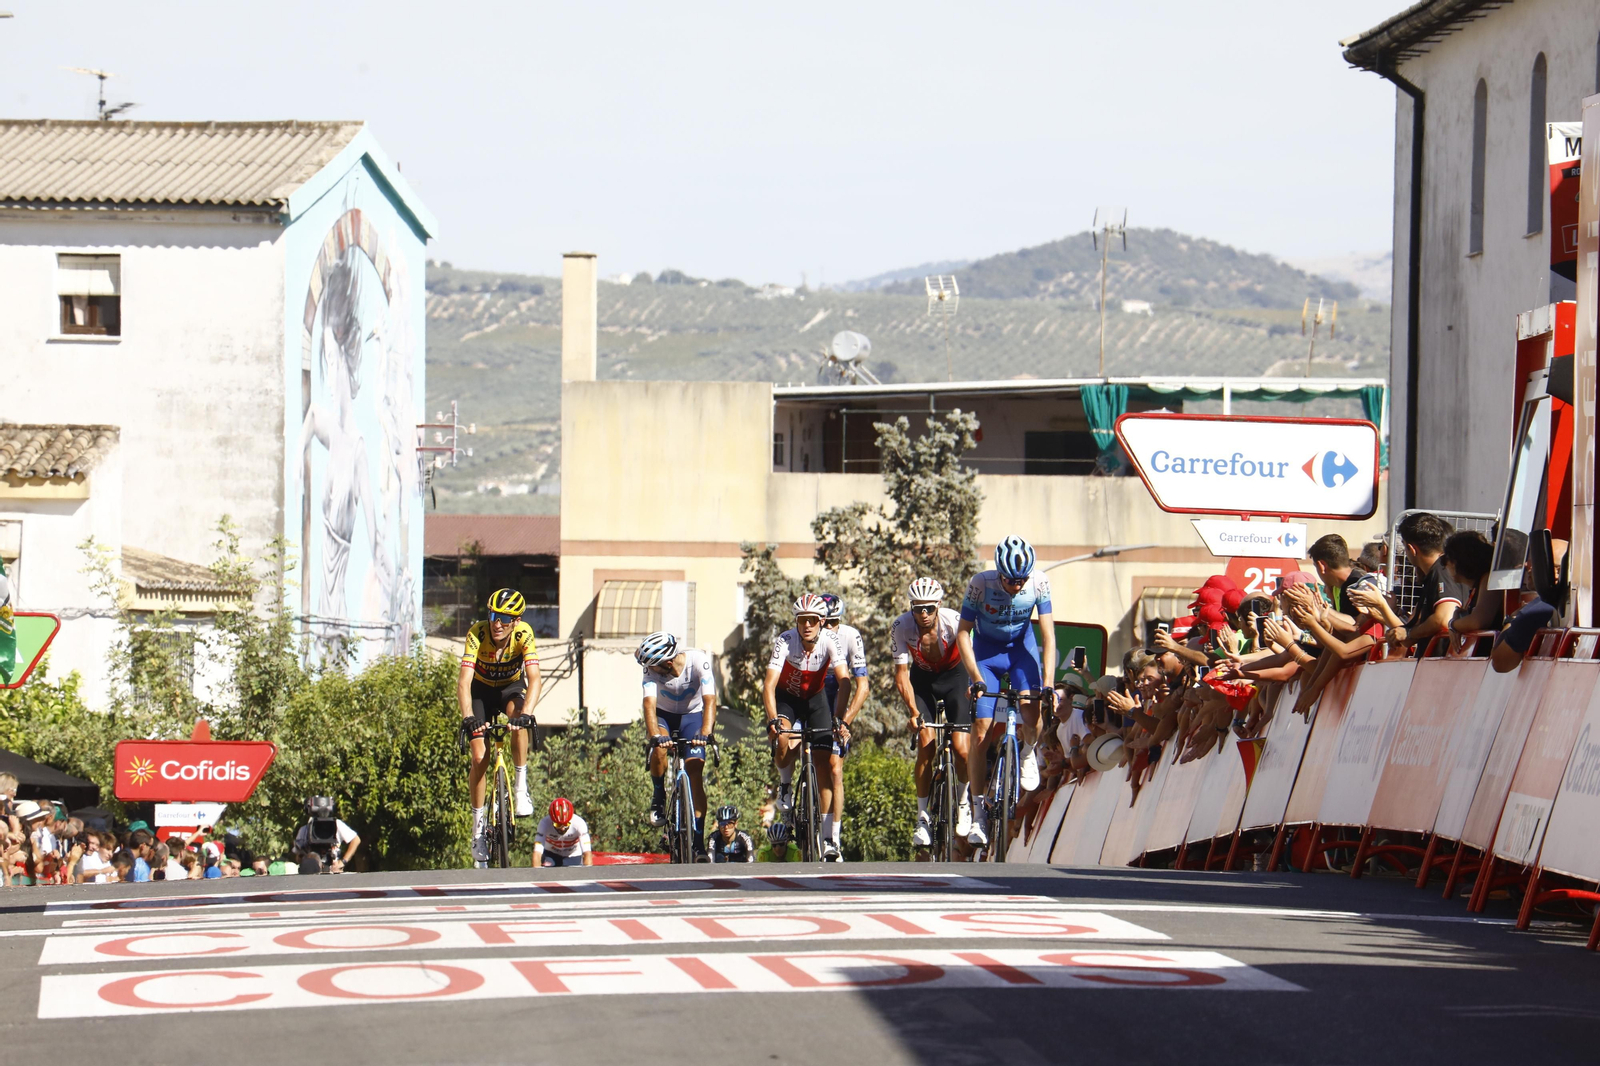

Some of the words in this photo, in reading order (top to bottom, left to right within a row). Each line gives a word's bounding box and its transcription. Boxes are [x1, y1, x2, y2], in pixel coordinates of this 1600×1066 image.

[1150, 450, 1289, 479] Carrefour
[1219, 532, 1273, 544] Carrefour
[1243, 567, 1282, 596] 25
[160, 759, 251, 781] Cofidis
[90, 873, 953, 911] COFIDIS
[94, 912, 1101, 958] COFIDIS
[97, 951, 1228, 1009] COFIDIS
